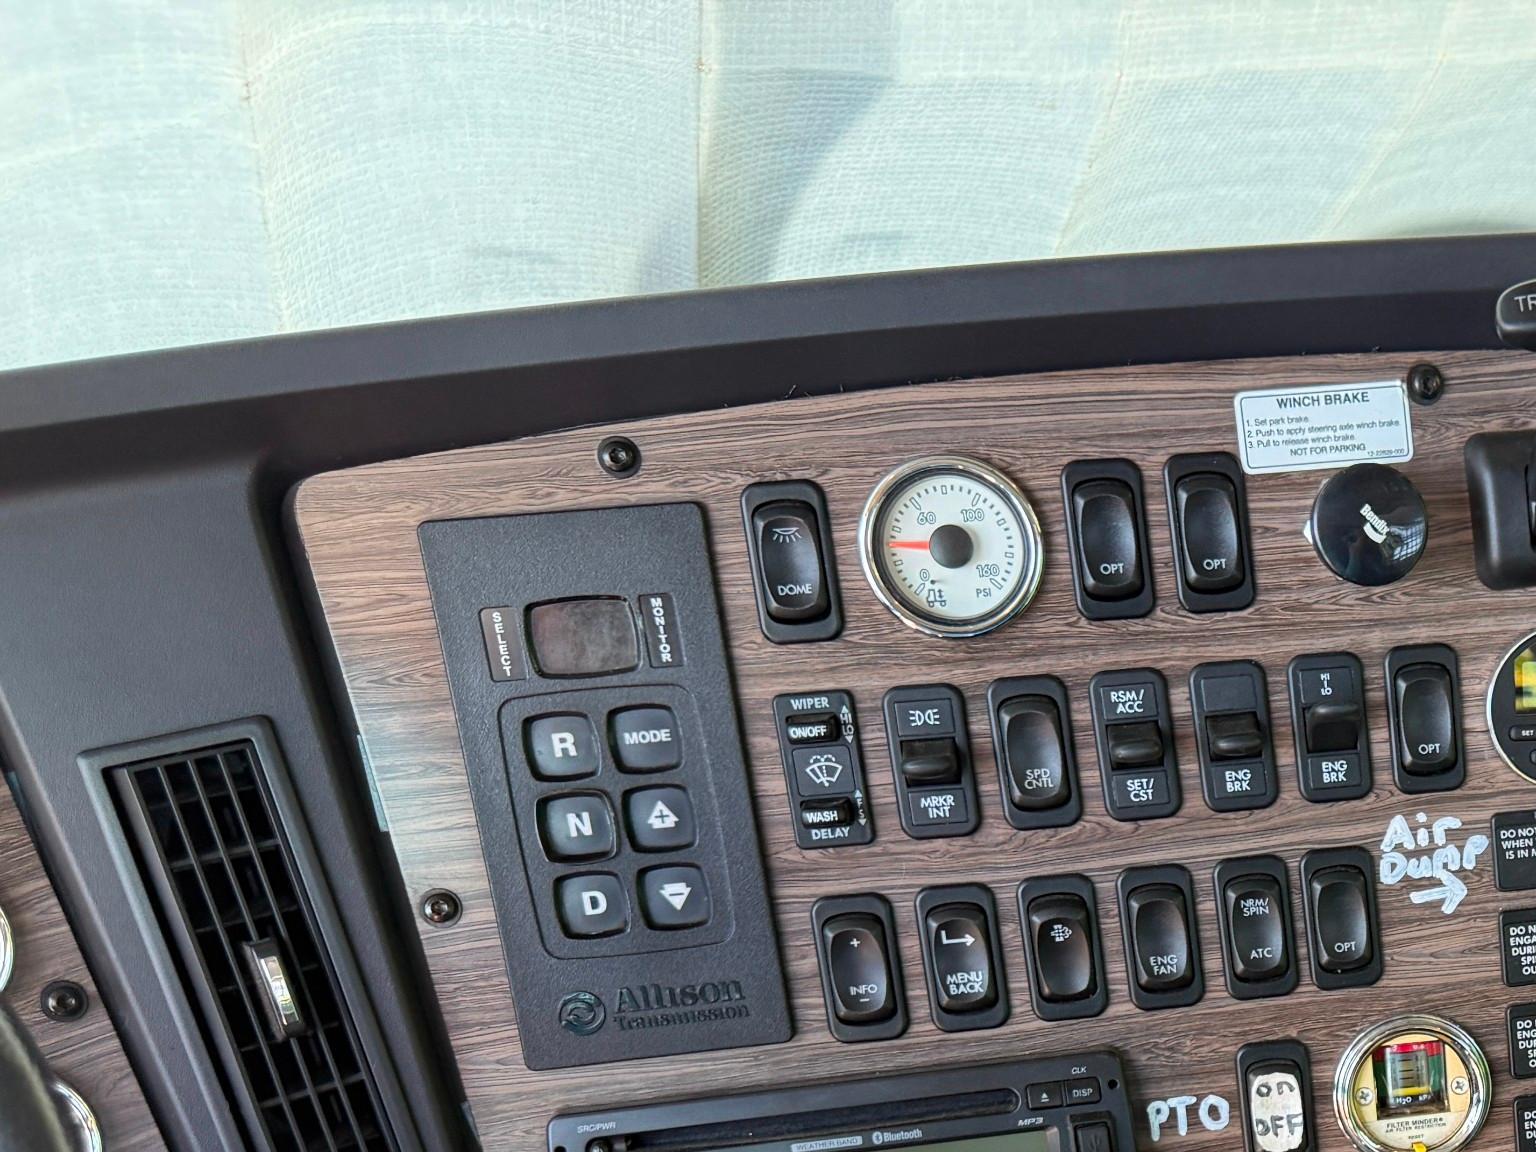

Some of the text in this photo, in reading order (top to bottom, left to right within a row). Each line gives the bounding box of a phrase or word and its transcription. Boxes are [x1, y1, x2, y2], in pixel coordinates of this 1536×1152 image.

[1277, 391, 1370, 409] WINCH BRAKE
[1254, 418, 1267, 427] Set
[1269, 416, 1285, 426] park
[1256, 428, 1275, 437] Push
[1286, 425, 1306, 436] apply
[1308, 423, 1337, 433] steering
[1339, 422, 1354, 431] axle
[1356, 420, 1377, 430] winch
[1257, 439, 1271, 448] Pull
[1281, 437, 1309, 445] release
[1310, 435, 1333, 443] winch
[1290, 448, 1310, 456] NOT
[1312, 446, 1326, 454] FOR
[1329, 443, 1366, 453] PARKING
[917, 511, 936, 524] 60
[961, 509, 984, 522] 100
[1360, 503, 1390, 536] Bendix
[976, 563, 1000, 578] 160
[1100, 562, 1124, 575] OPT
[1203, 558, 1227, 571] OPT
[919, 568, 929, 581] 0
[777, 583, 813, 596] DOME
[976, 587, 991, 598] PSI
[651, 597, 672, 663] MONITOR
[491, 612, 512, 678] SELECT
[1110, 689, 1145, 703] RSM/
[791, 696, 830, 711] WIPER
[1116, 701, 1144, 714] ACC
[624, 727, 672, 745] MODE
[789, 725, 828, 739] ON/OFF
[1521, 729, 1534, 737] SET
[551, 731, 578, 758] R
[1418, 743, 1440, 755] OPT
[1321, 759, 1347, 772] ENG
[1026, 768, 1050, 780] SPD
[1225, 769, 1252, 782] ENG
[1323, 770, 1347, 783] BRK
[1024, 777, 1054, 790] CNTL
[1126, 778, 1154, 792] SET/
[1226, 780, 1251, 793] BRK
[920, 794, 955, 808] MRKR
[1130, 789, 1153, 802] CST
[806, 810, 839, 823] WASH
[928, 805, 951, 819] INT
[566, 811, 594, 837] N
[811, 827, 850, 840] DELAY
[1380, 812, 1462, 853] Air
[1500, 829, 1516, 839] DO
[1502, 837, 1533, 850] WHEN
[1505, 849, 1516, 860] IS
[1517, 848, 1529, 858] IN
[582, 890, 607, 916] D
[1241, 898, 1269, 908] NRM/
[1243, 905, 1269, 917] SPIN
[1509, 926, 1526, 936] DO
[1250, 947, 1273, 960] ATC
[1334, 941, 1356, 953] OPT
[1150, 954, 1178, 967] ENG
[1154, 964, 1177, 976] FAN
[947, 971, 984, 985] MENU
[850, 983, 878, 996] INFO
[950, 982, 985, 995] BACK
[616, 980, 747, 1014] Allison
[612, 1004, 750, 1031] Transmission
[1516, 1020, 1532, 1029] DO
[1071, 1066, 1087, 1075] CLK
[1072, 1088, 1093, 1097] DISP
[1017, 1117, 1044, 1127] MP3
[1146, 1094, 1230, 1142] PTO
[1387, 1120, 1410, 1129] FILTER
[1255, 1113, 1303, 1138] OFF
[884, 1128, 923, 1143] Bluetooth
